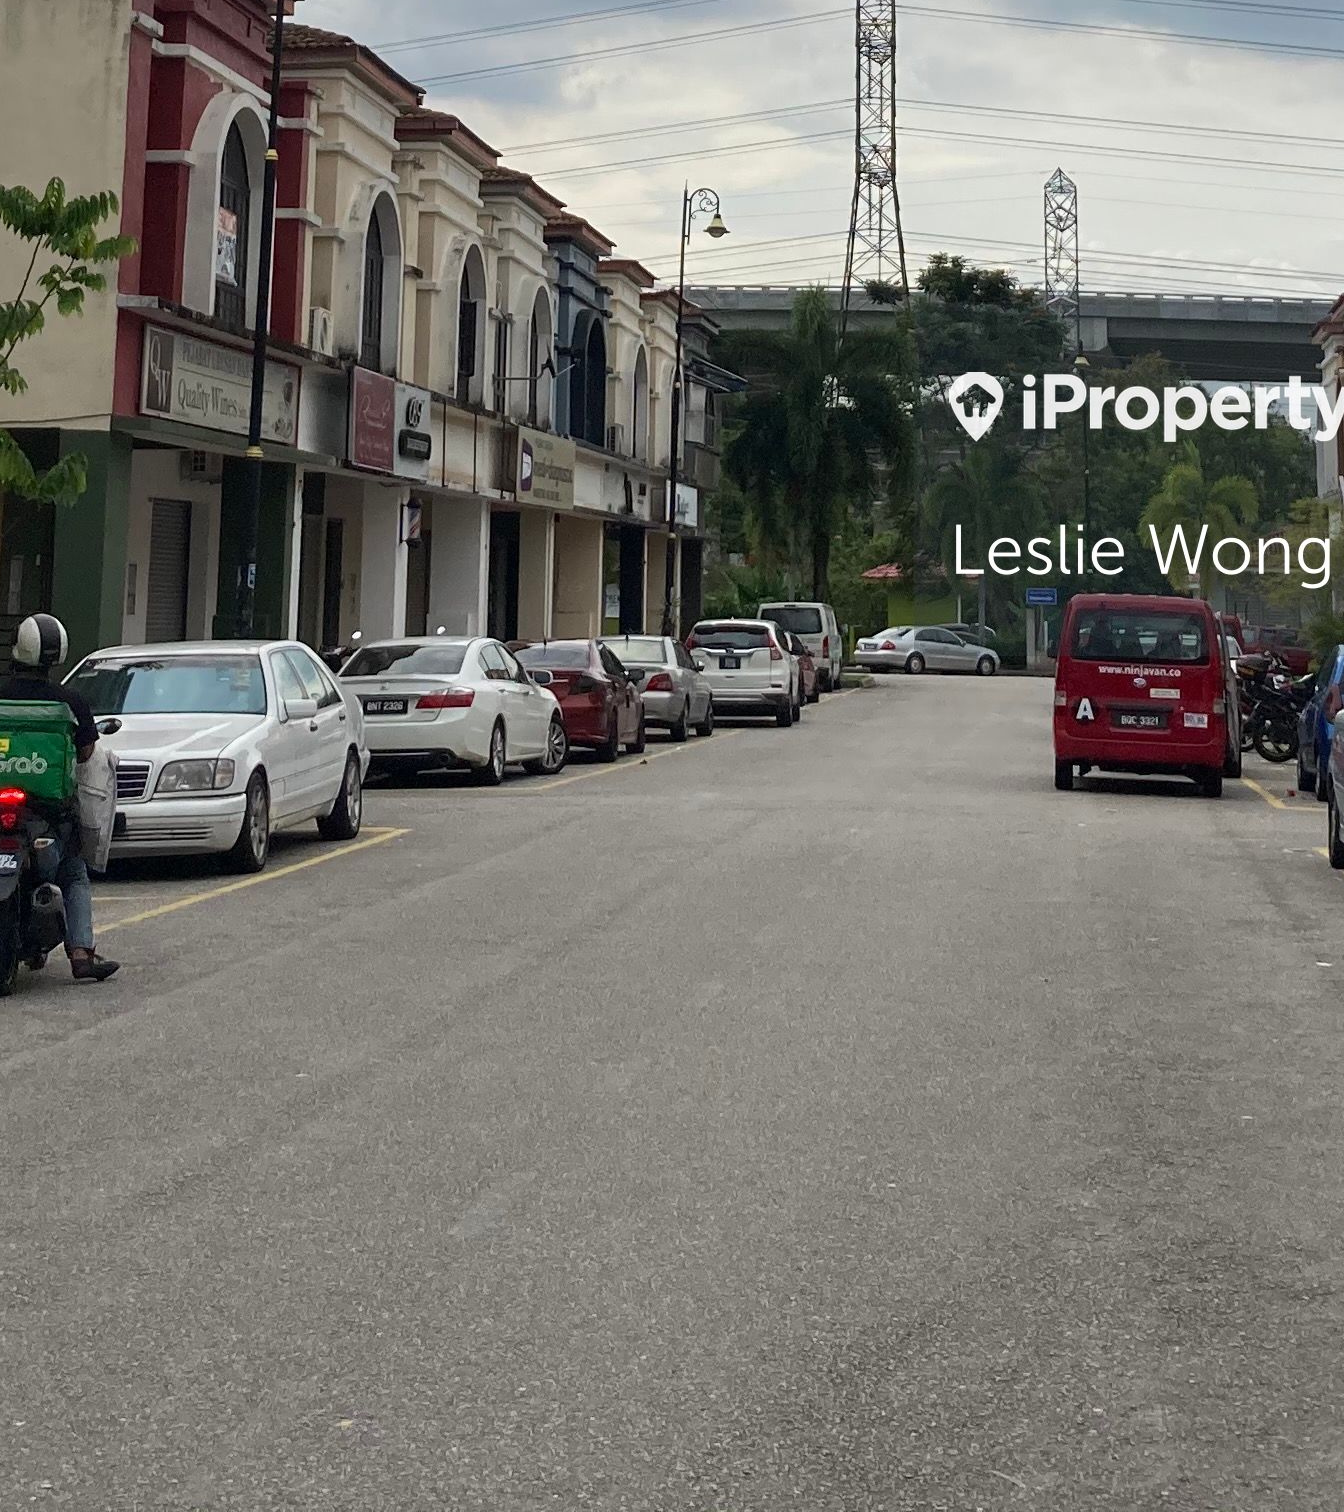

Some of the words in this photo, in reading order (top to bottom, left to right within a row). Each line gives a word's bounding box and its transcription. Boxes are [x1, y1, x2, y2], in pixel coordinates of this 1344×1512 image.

[178, 378, 210, 417] Quality
[211, 386, 238, 418] Wines
[1098, 665, 1181, 677] www.ninjavan.co
[1076, 698, 1094, 720] A
